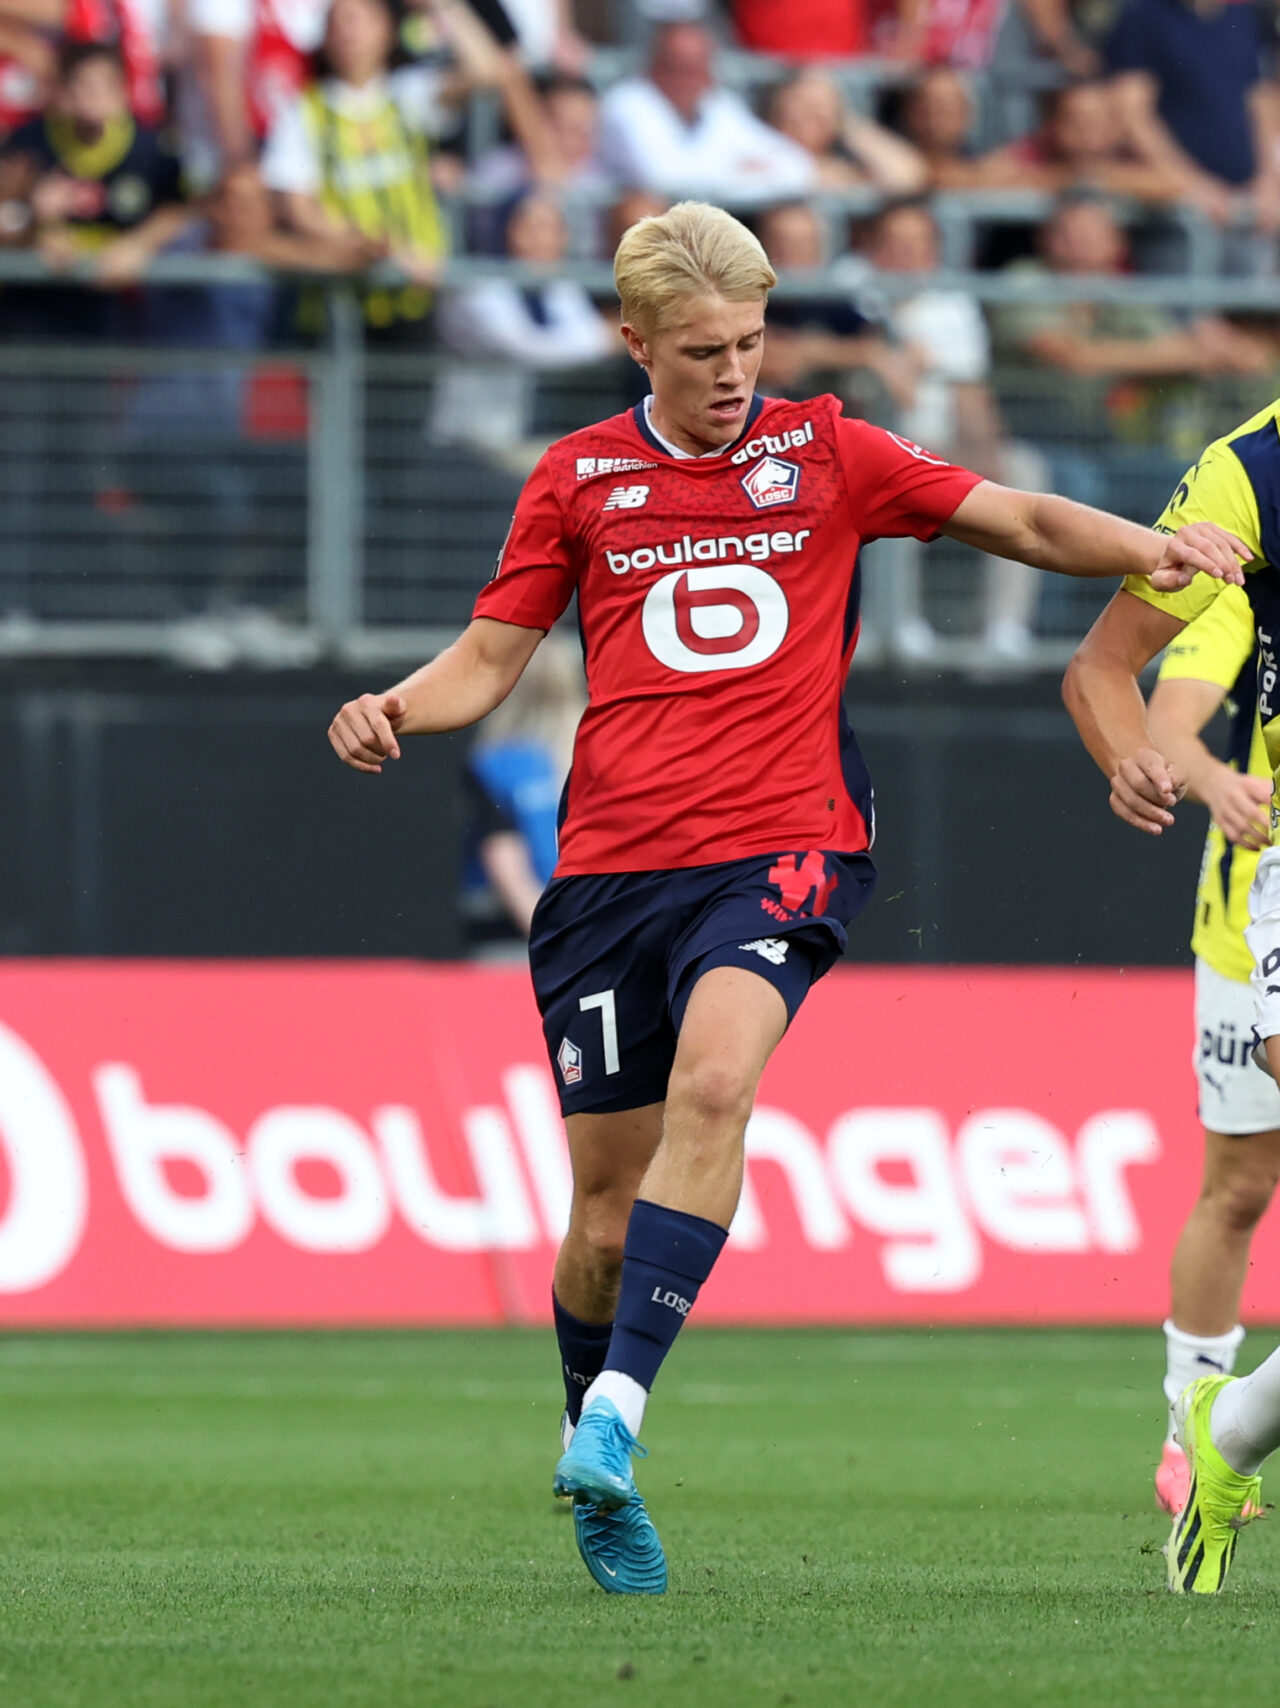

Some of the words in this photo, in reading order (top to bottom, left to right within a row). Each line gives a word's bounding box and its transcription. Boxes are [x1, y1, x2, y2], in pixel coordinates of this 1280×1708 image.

[730, 421, 815, 465] actual
[758, 489, 790, 505] LOSC
[605, 529, 811, 576] boulanger
[579, 989, 621, 1076] 7
[95, 1063, 1161, 1292] boulnger
